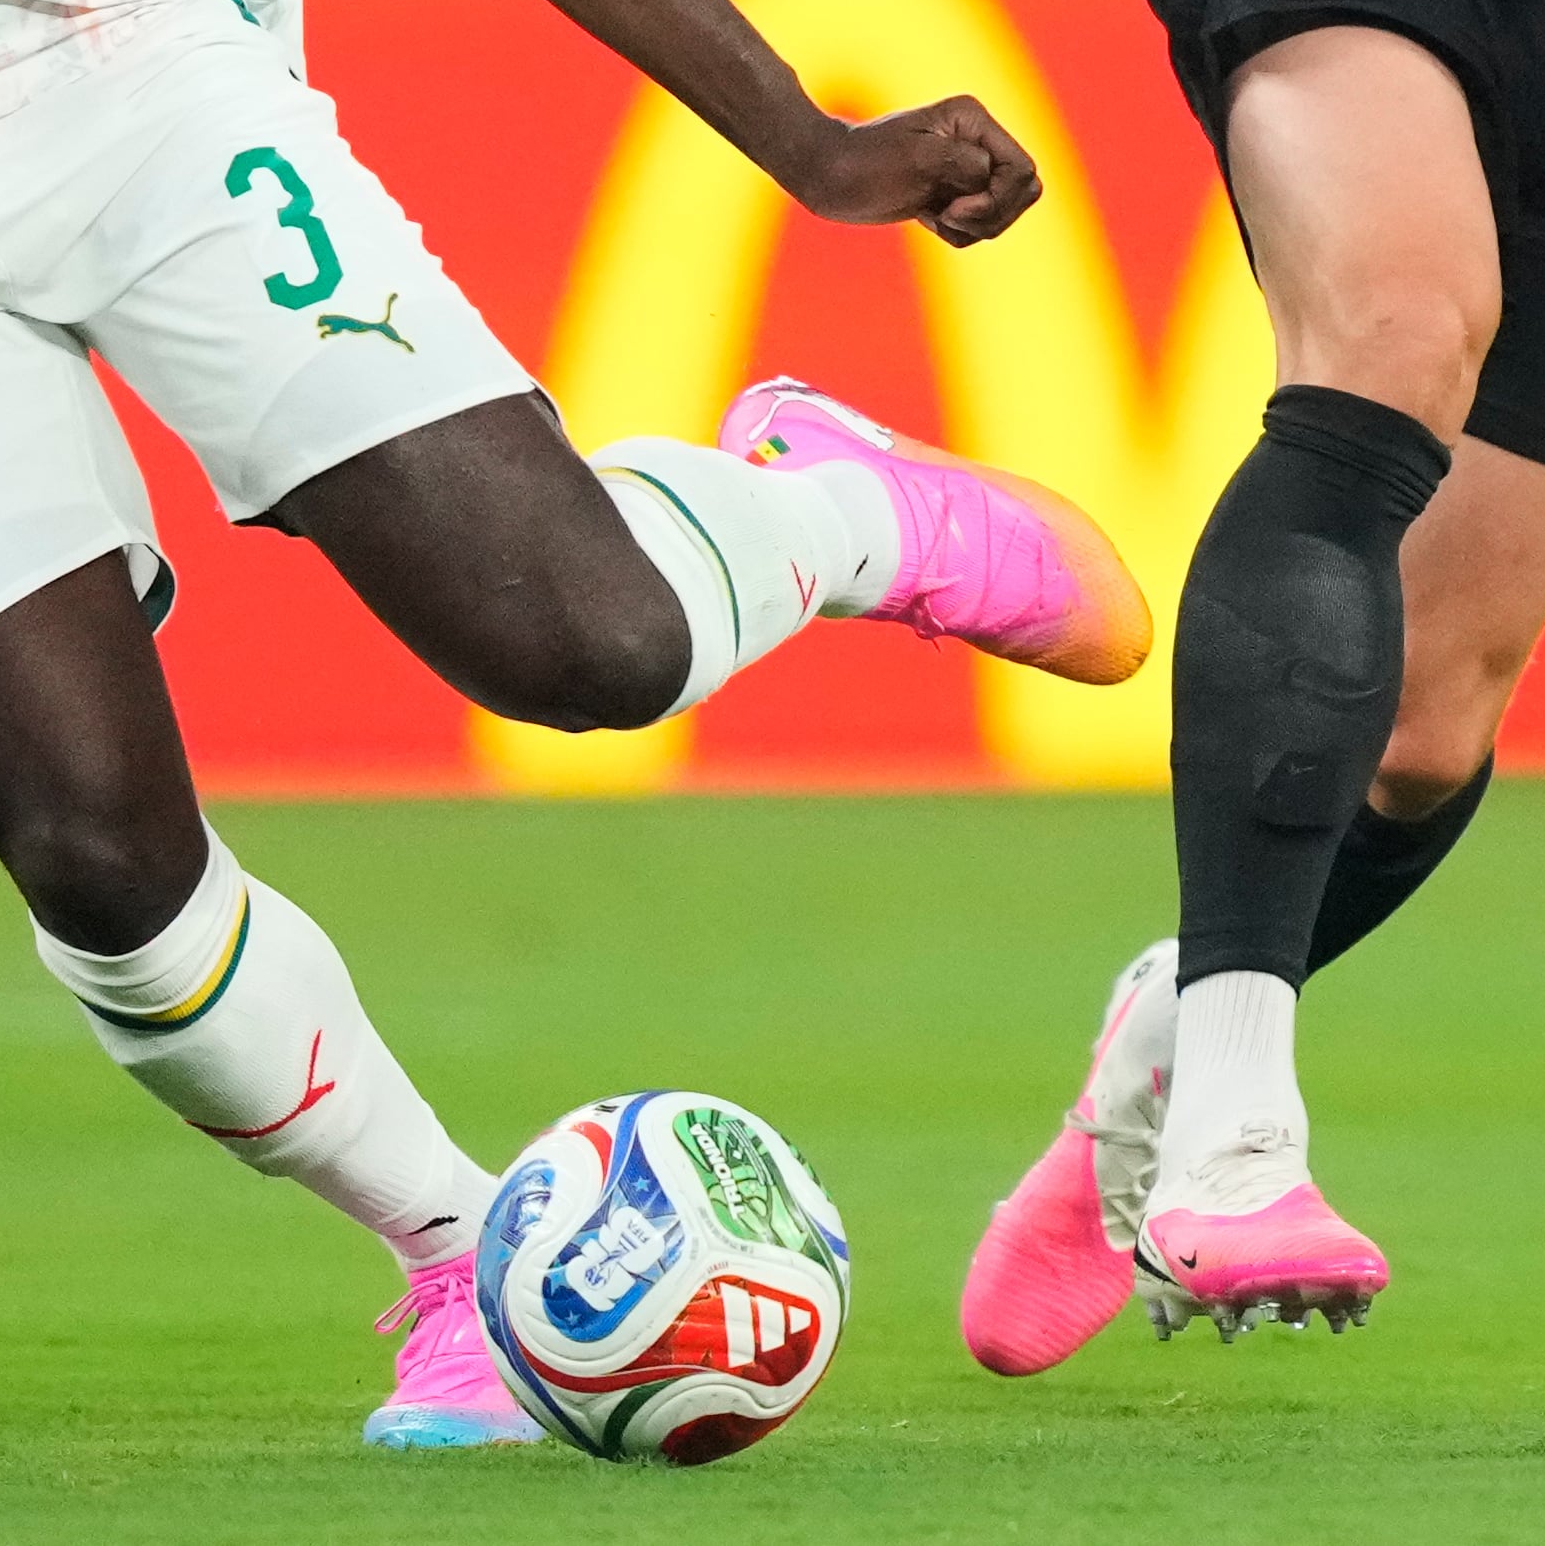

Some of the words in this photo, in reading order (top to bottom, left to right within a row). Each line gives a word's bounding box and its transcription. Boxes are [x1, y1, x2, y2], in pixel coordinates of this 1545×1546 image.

[225, 146, 343, 311] 3
[689, 1122, 746, 1221] TRIONDA
[627, 1217, 651, 1244] FIFA
